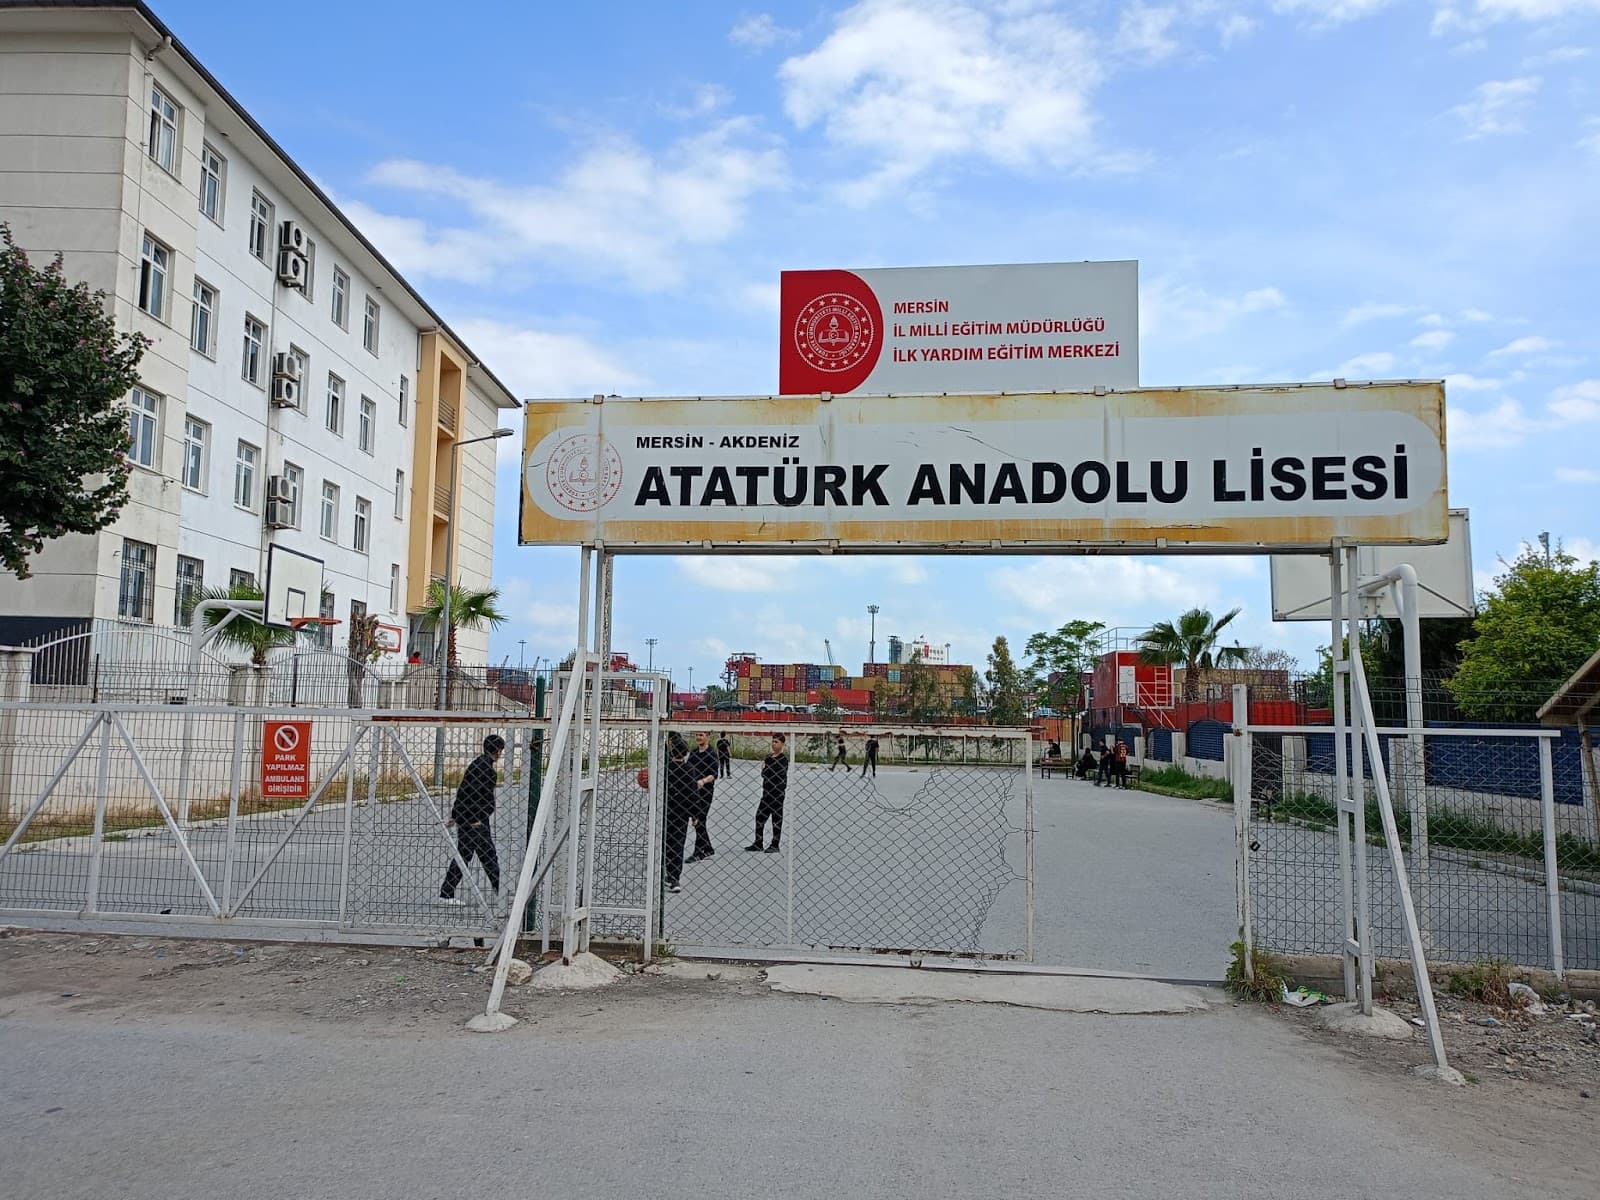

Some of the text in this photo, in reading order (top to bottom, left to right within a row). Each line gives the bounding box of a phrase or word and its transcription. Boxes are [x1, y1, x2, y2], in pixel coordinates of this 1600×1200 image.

[893, 298, 949, 314] MERSİN
[893, 316, 1106, 338] İL MİLLİ EĞİTİM MÜDÜRLÜĞÜ
[893, 341, 1120, 363] İLK YARDIM EĞİTİM MERKEZİ
[636, 433, 704, 449] MERSİN
[719, 432, 800, 449] AKDENİZ
[634, 456, 890, 507] ATATÜRK
[906, 460, 1189, 506] ANADOLU
[1213, 444, 1409, 502] LİSESİ
[274, 753, 297, 762] PARK
[265, 763, 305, 771] YAPILMAZ
[265, 775, 305, 783] AMBULANS
[267, 785, 302, 794] GİRİŞİDİR
